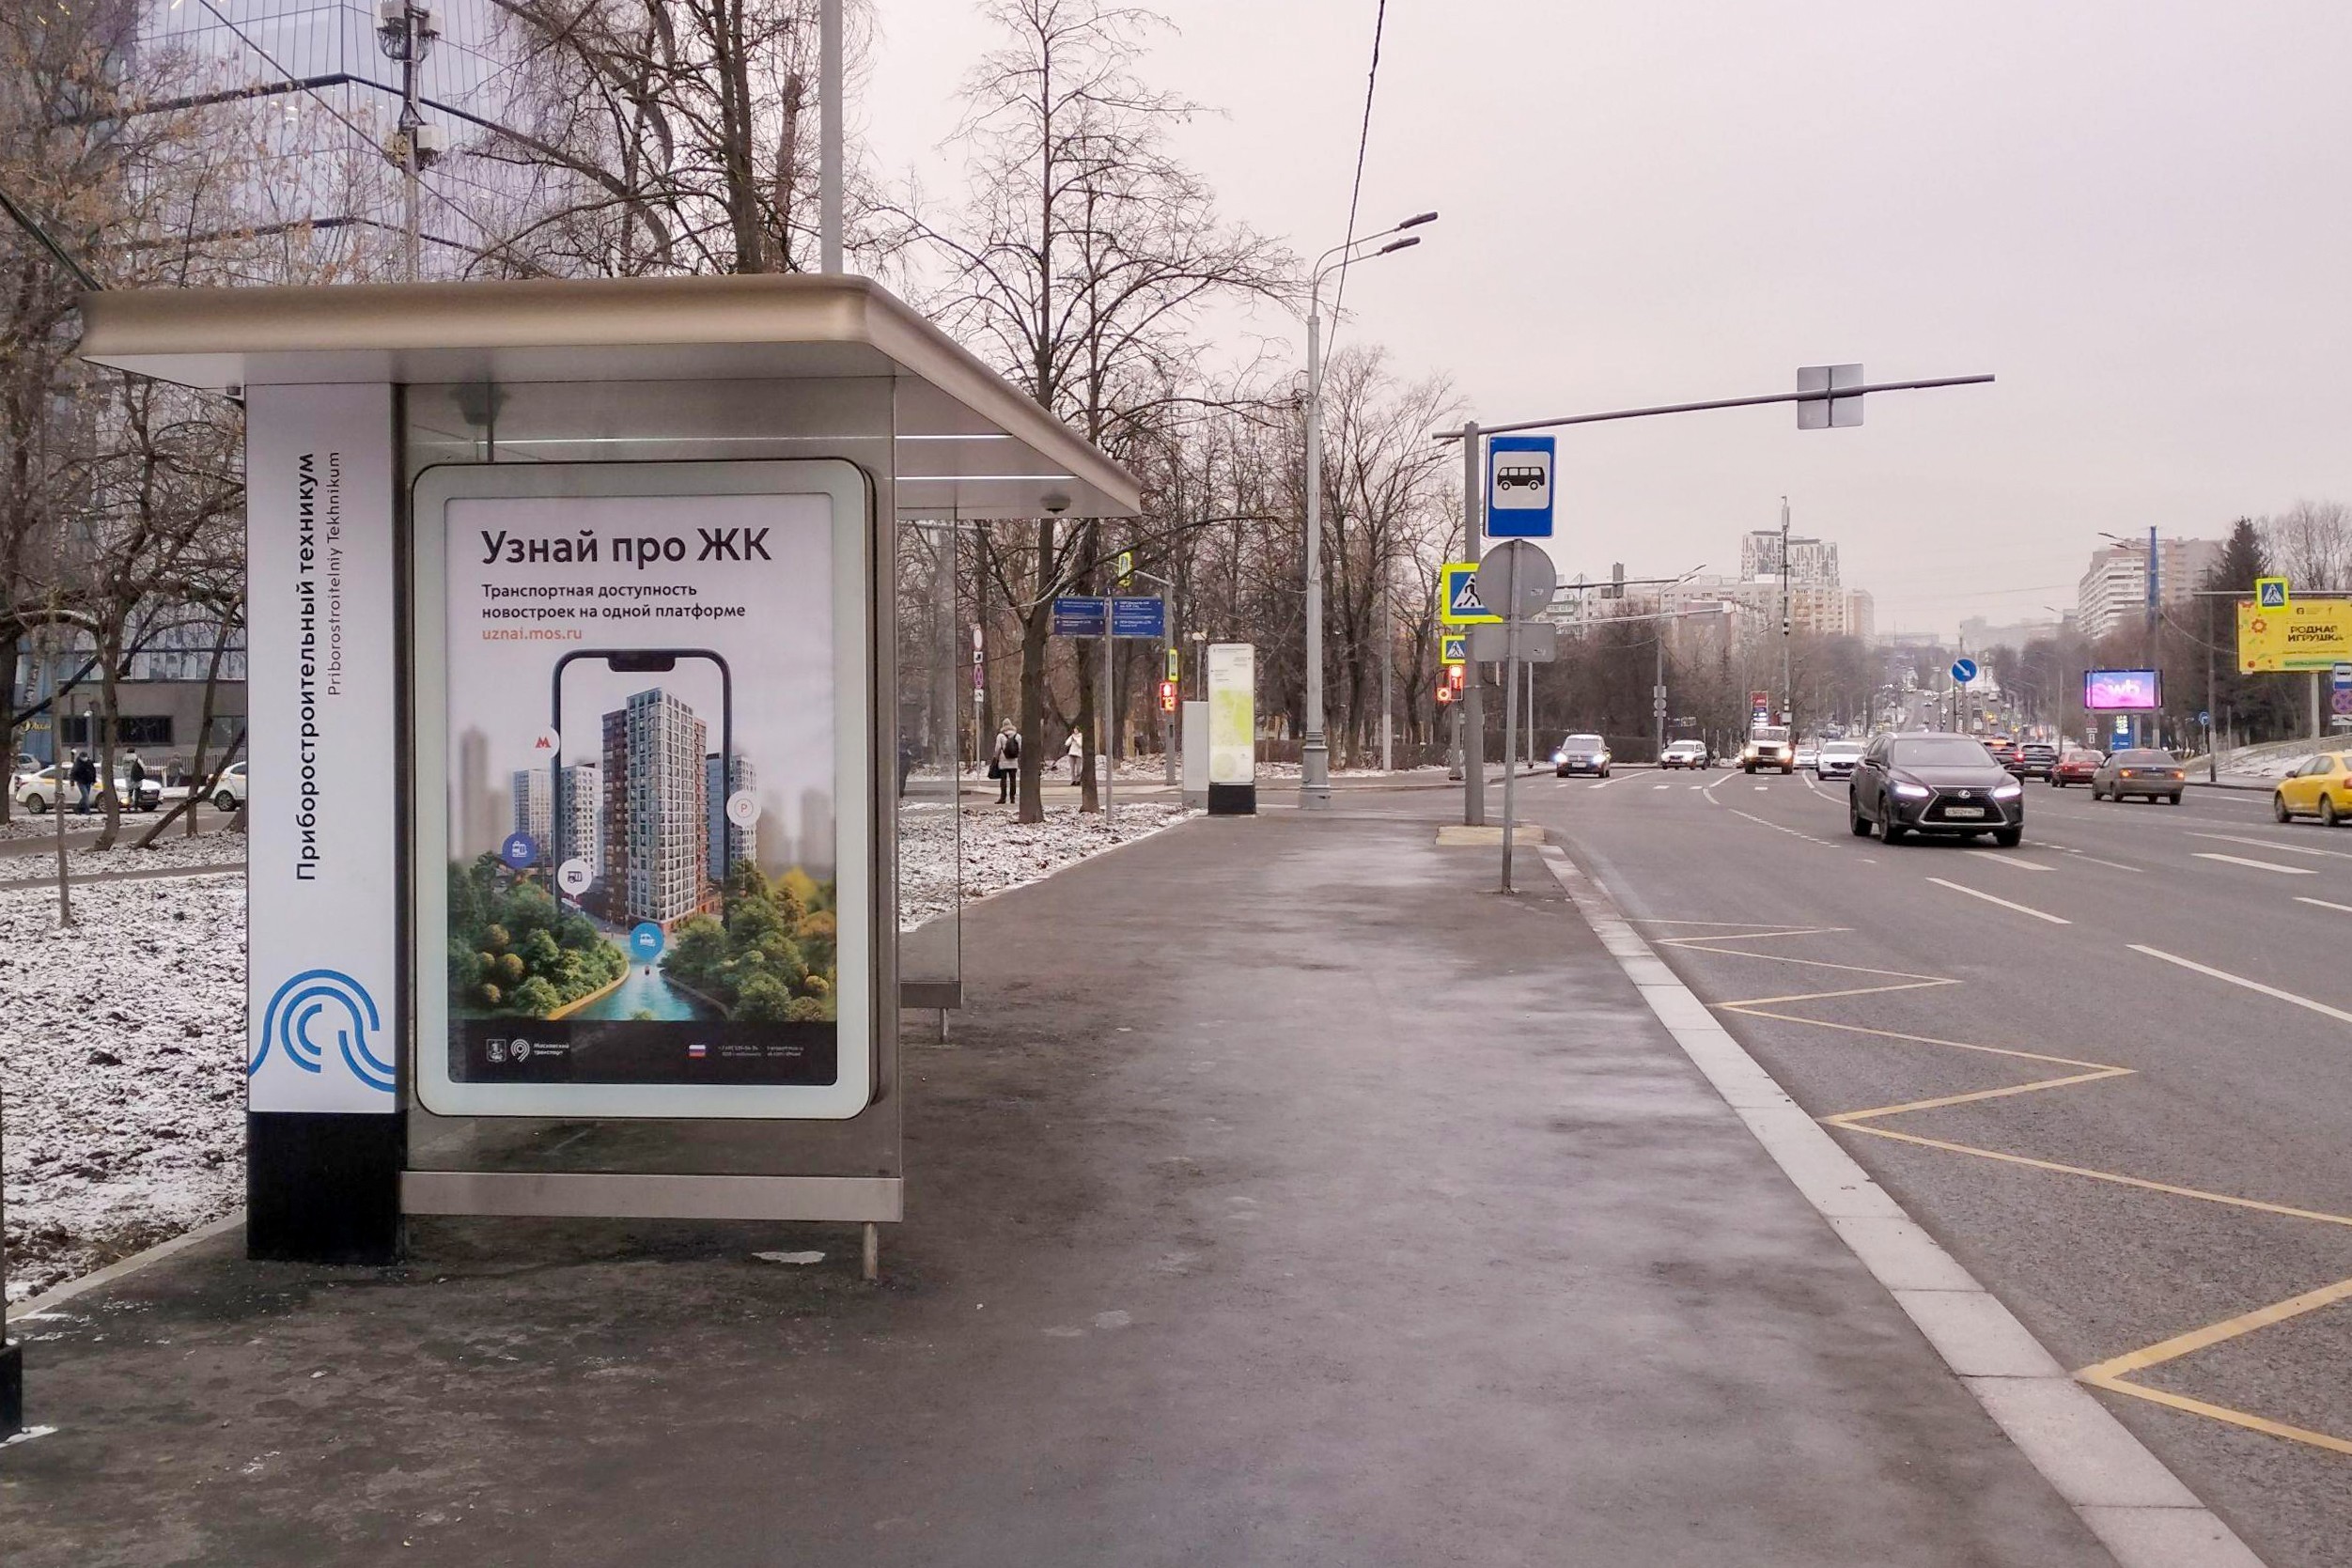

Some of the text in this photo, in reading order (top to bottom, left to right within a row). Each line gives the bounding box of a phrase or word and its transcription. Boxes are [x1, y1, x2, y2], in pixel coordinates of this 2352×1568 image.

[480, 527, 772, 570] Узнай про ЖК
[326, 452, 343, 695] Priborostroitelniy Tekhnikum
[481, 583, 697, 600] Транспортная доступность
[482, 603, 746, 621] новостроек на одной платформе
[482, 627, 583, 641] uznai.mos.ru
[295, 453, 320, 880] Приборостроительный техникум
[2109, 678, 2142, 695] wb
